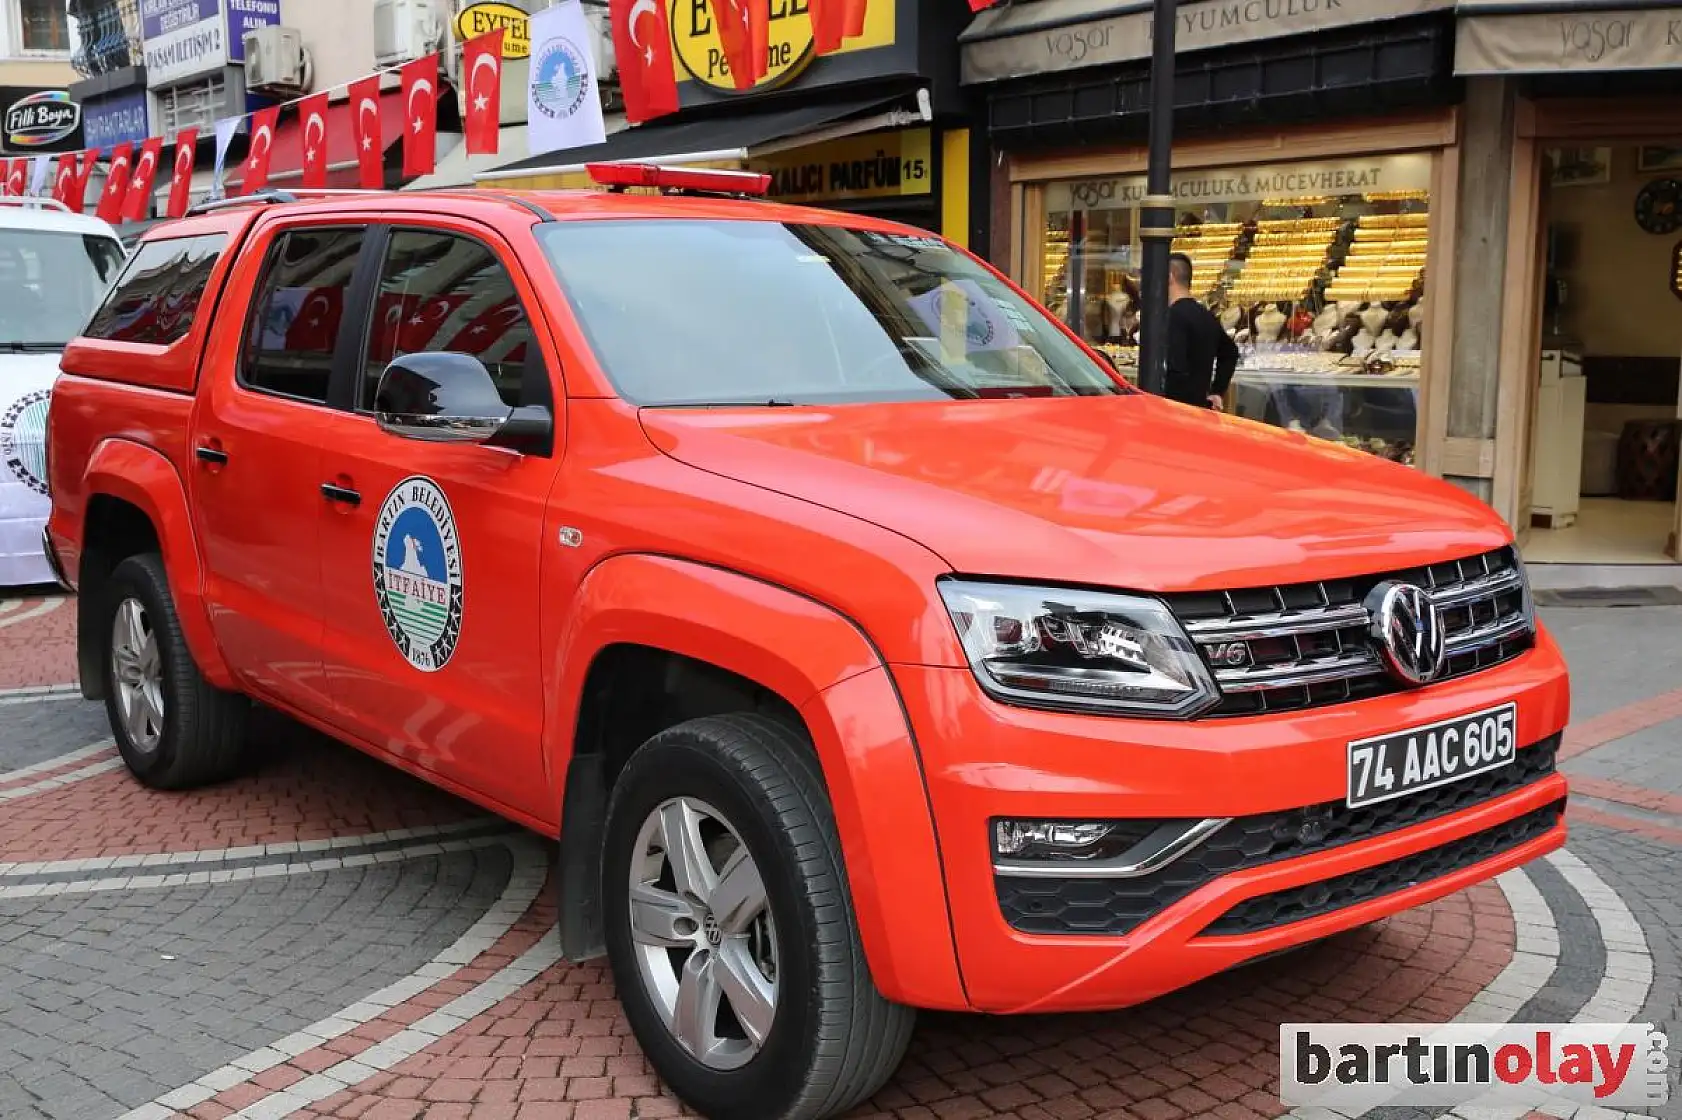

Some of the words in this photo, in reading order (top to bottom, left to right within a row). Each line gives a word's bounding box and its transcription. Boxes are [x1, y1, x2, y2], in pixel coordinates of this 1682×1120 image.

[707, 41, 791, 78] Peme
[10, 107, 35, 130] Filli
[37, 105, 74, 128] Boya
[1121, 178, 1234, 203] KUCULUK
[1254, 167, 1382, 193] MÜCEVHERAT
[412, 485, 461, 579] BELEDİYESİ
[388, 569, 447, 605] İTFAİYE
[1205, 643, 1247, 666] V6
[1352, 744, 1395, 798] 74
[1402, 727, 1459, 786] AAC
[1464, 710, 1513, 767] 605
